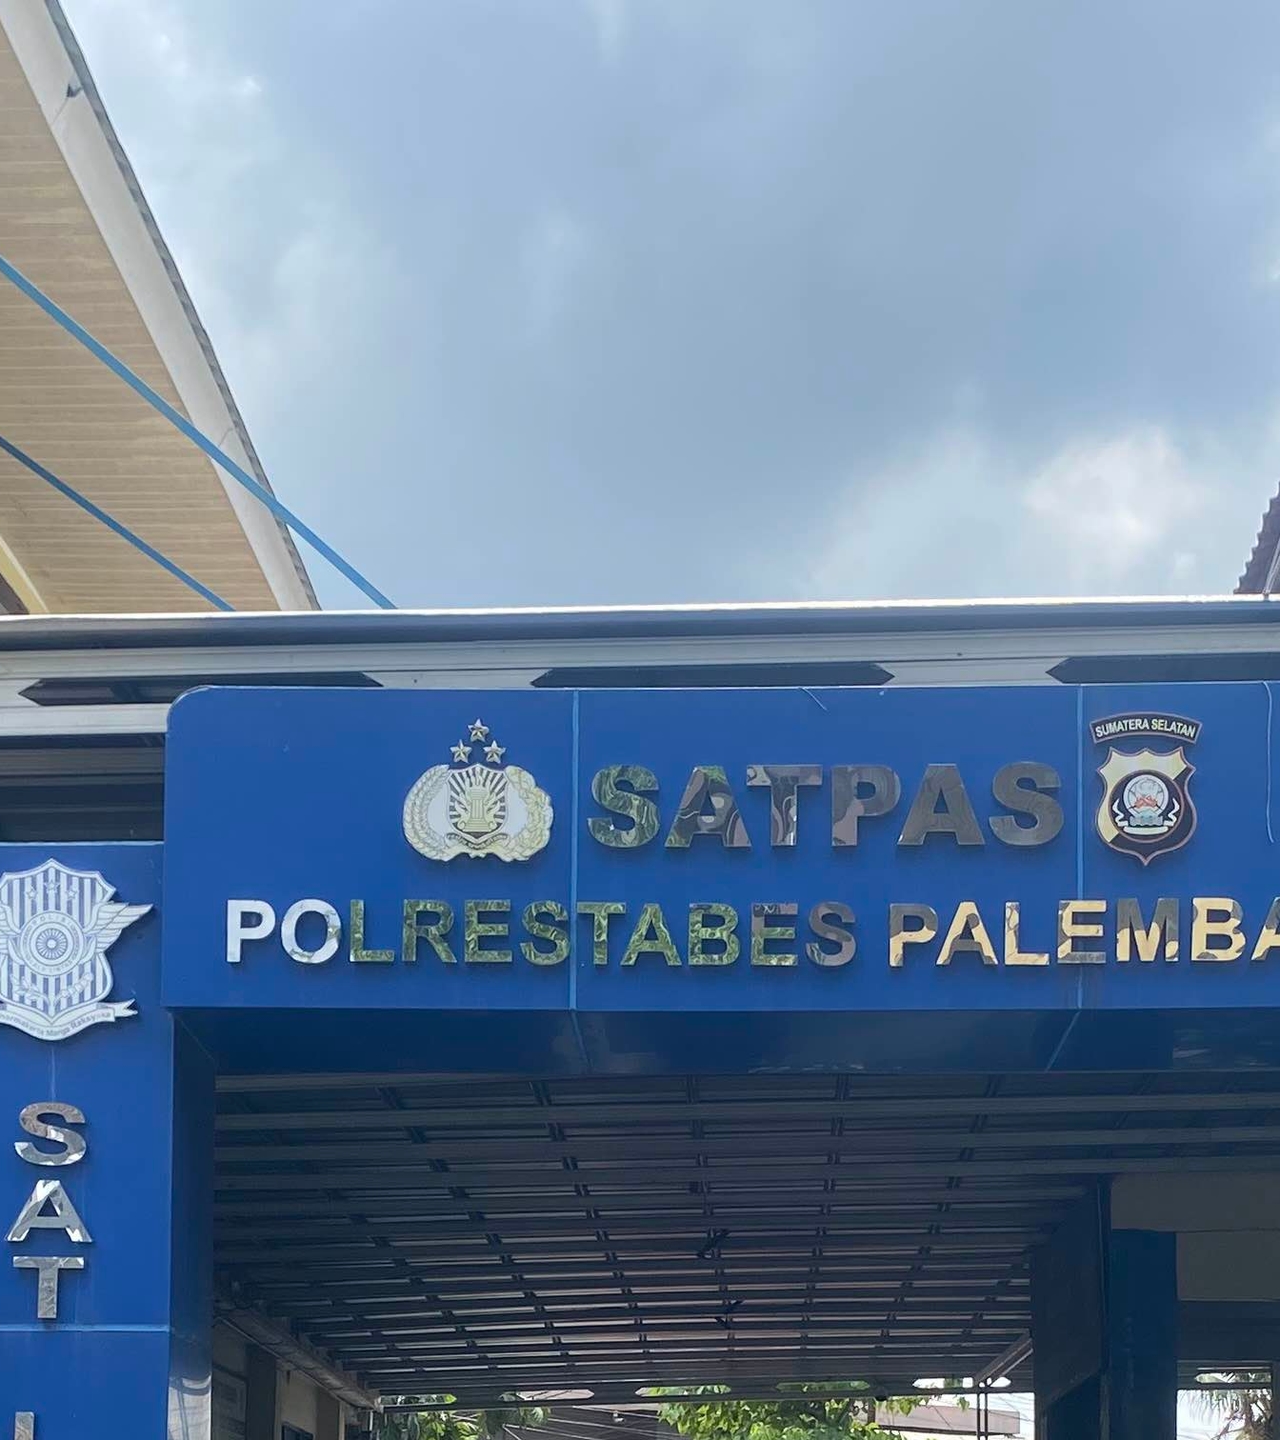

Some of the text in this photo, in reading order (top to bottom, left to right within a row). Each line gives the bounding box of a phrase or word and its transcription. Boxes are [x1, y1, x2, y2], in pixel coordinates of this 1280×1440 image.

[1095, 718, 1196, 738] SUMATERA SELATAN
[587, 762, 1064, 849] SATPAS
[225, 898, 857, 966] POLRESTABES
[5, 1101, 93, 1319] SAT
